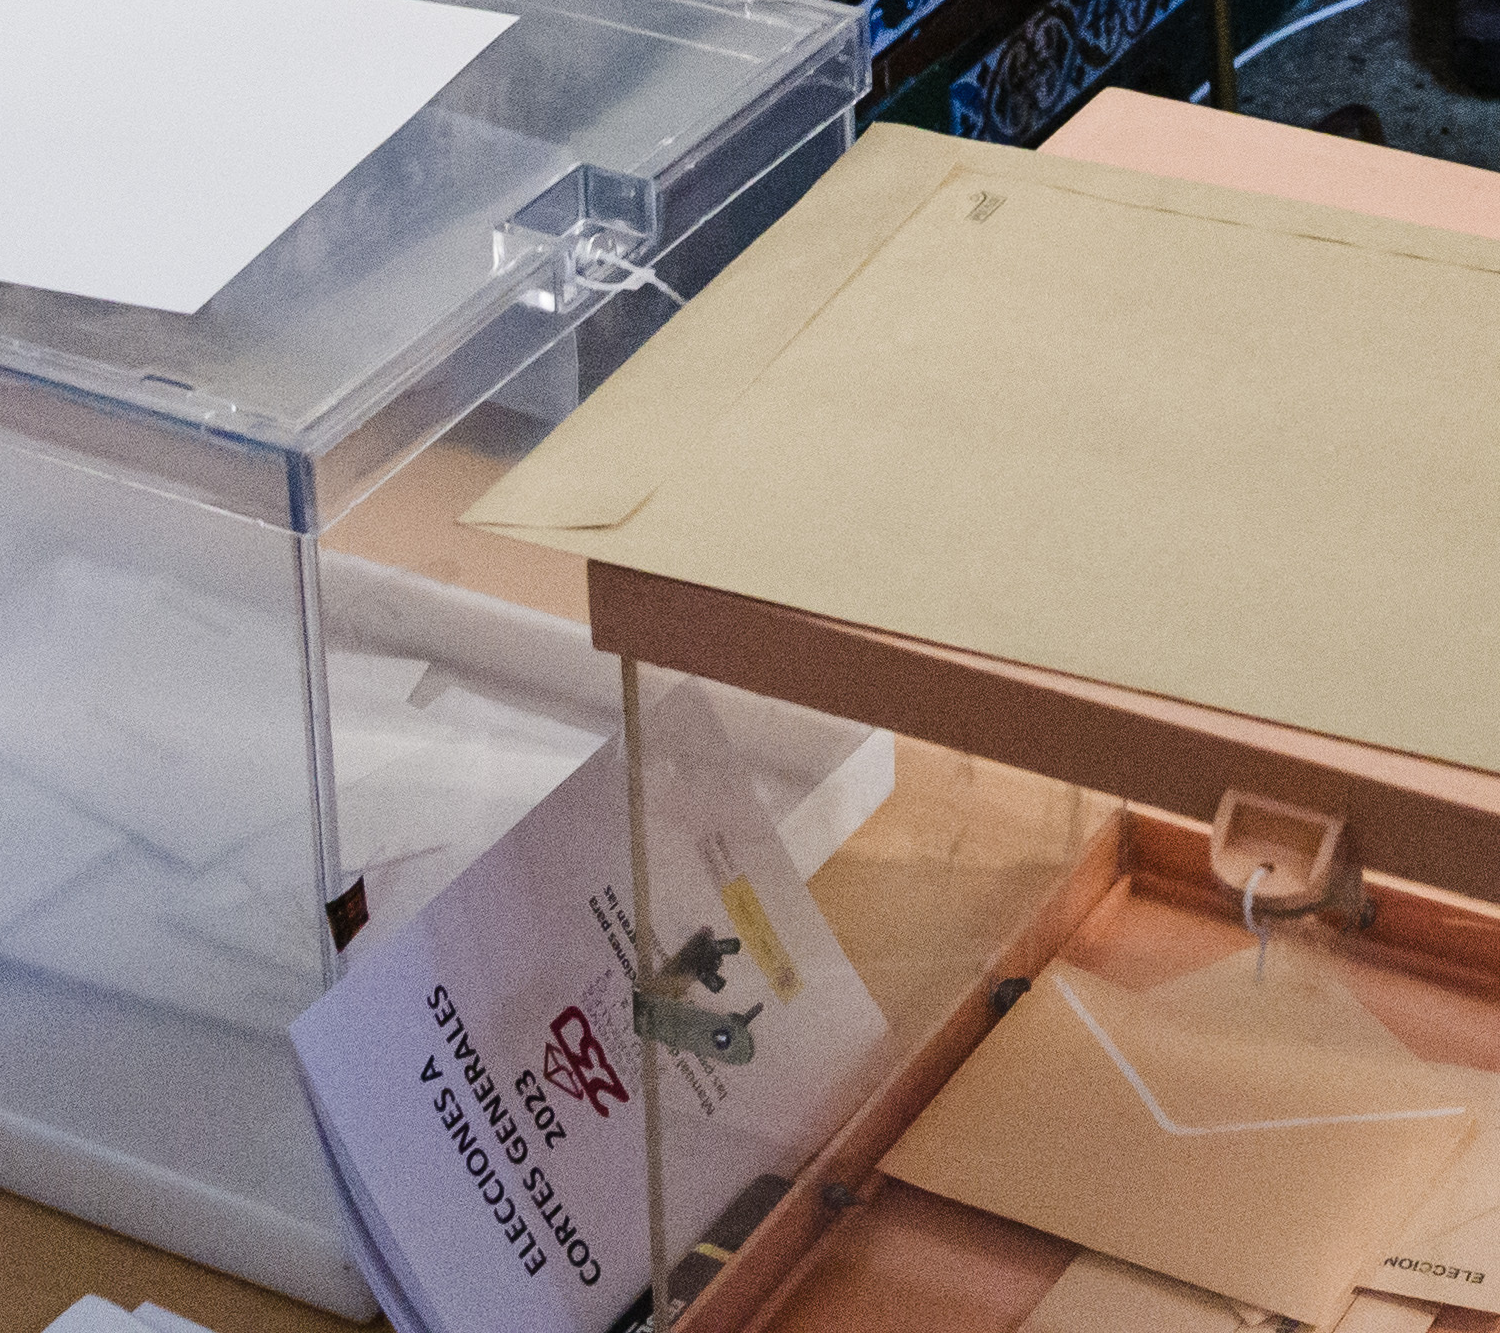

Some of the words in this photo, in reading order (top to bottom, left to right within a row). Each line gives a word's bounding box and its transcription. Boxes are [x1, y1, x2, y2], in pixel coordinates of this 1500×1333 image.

[588, 895, 612, 933] para
[603, 884, 619, 912] las
[419, 1054, 444, 1084] A
[426, 984, 529, 1165] GENERALES
[676, 1055, 716, 1117] Manual
[514, 1069, 568, 1150] 2023
[433, 1087, 548, 1278] ELECCIONES
[522, 1166, 601, 1286] CORTES
